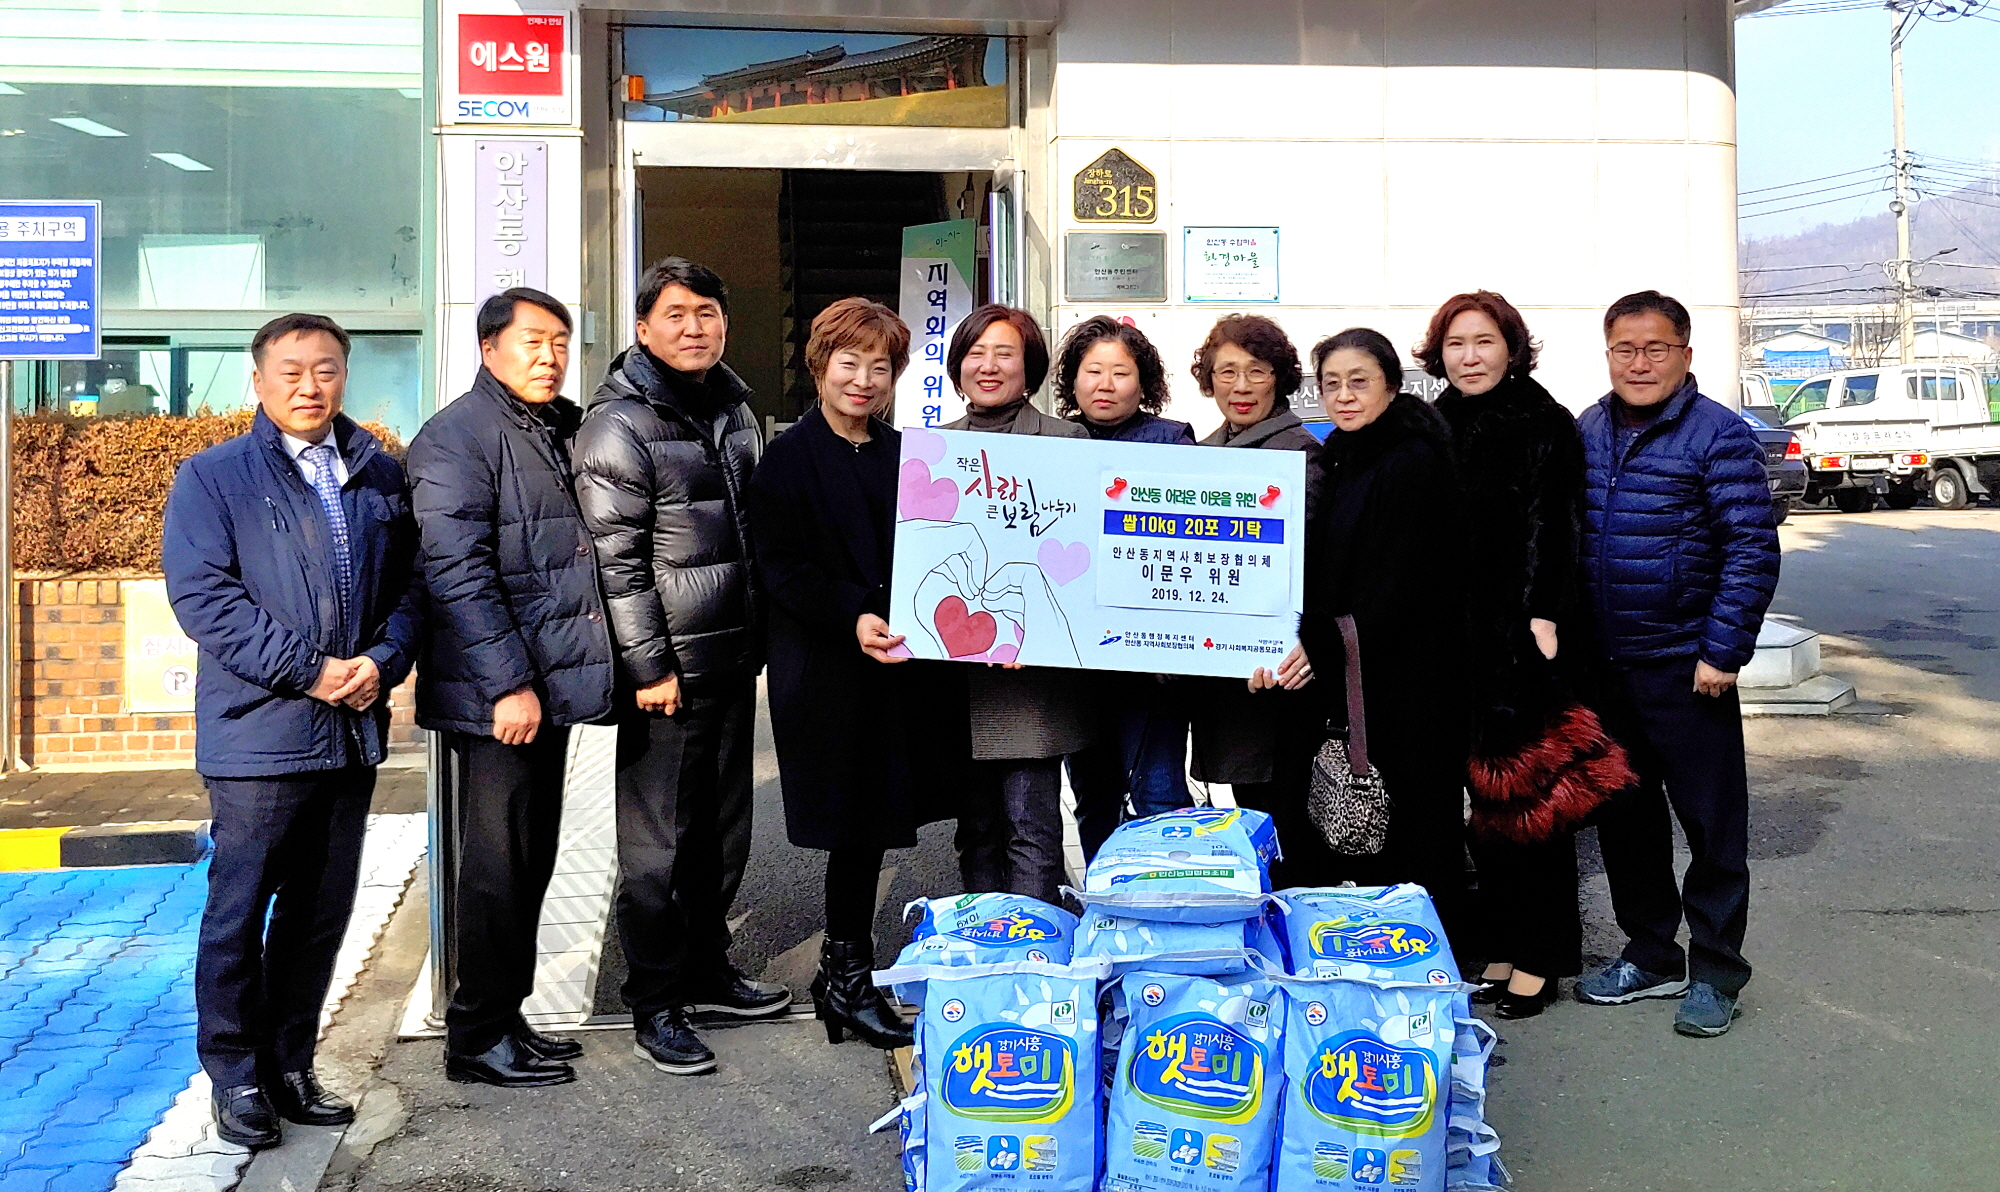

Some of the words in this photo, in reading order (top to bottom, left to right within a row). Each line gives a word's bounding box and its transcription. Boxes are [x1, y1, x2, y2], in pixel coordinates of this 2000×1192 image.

[470, 41, 550, 72] 에스원
[458, 100, 529, 118] SECOM
[1087, 168, 1113, 178] 장하로
[491, 151, 528, 256] 안산동
[1096, 184, 1154, 218] 315
[17, 221, 76, 237] 주차구역
[925, 262, 948, 366] 지역회의
[922, 375, 943, 428] 위원
[956, 457, 982, 473] 작은
[964, 449, 1023, 502] 사랑
[1130, 486, 1161, 504] 안산동
[1166, 488, 1196, 505] 어려운
[1200, 490, 1232, 507] 이웃을
[1236, 492, 1256, 508] 위한
[986, 504, 998, 519] 큰
[1042, 498, 1076, 518] 나누기
[1122, 514, 1176, 536] 쌀10kg
[1184, 518, 1219, 536] 20포
[1230, 520, 1262, 539] 기탁
[1142, 564, 1193, 583] 이문우
[1208, 568, 1240, 586] 위원
[1152, 588, 1182, 601] 2019.
[1189, 590, 1205, 602] 12.
[1212, 592, 1229, 604] 24.
[1124, 639, 1142, 647] 안산동
[1144, 640, 1195, 650] 지역사회보장협의체
[1216, 643, 1228, 651] 경기
[1228, 644, 1284, 654] 사회복지공동모금회
[1333, 928, 1431, 955] 햇토미
[998, 1036, 1042, 1052] 경기시흥
[1192, 1032, 1234, 1052] 경기시흥
[1146, 1029, 1242, 1084] 햇토미
[1362, 1050, 1403, 1069] 경기시흥
[952, 1041, 1050, 1095] 햇토미
[1320, 1048, 1412, 1103] 햇토미
